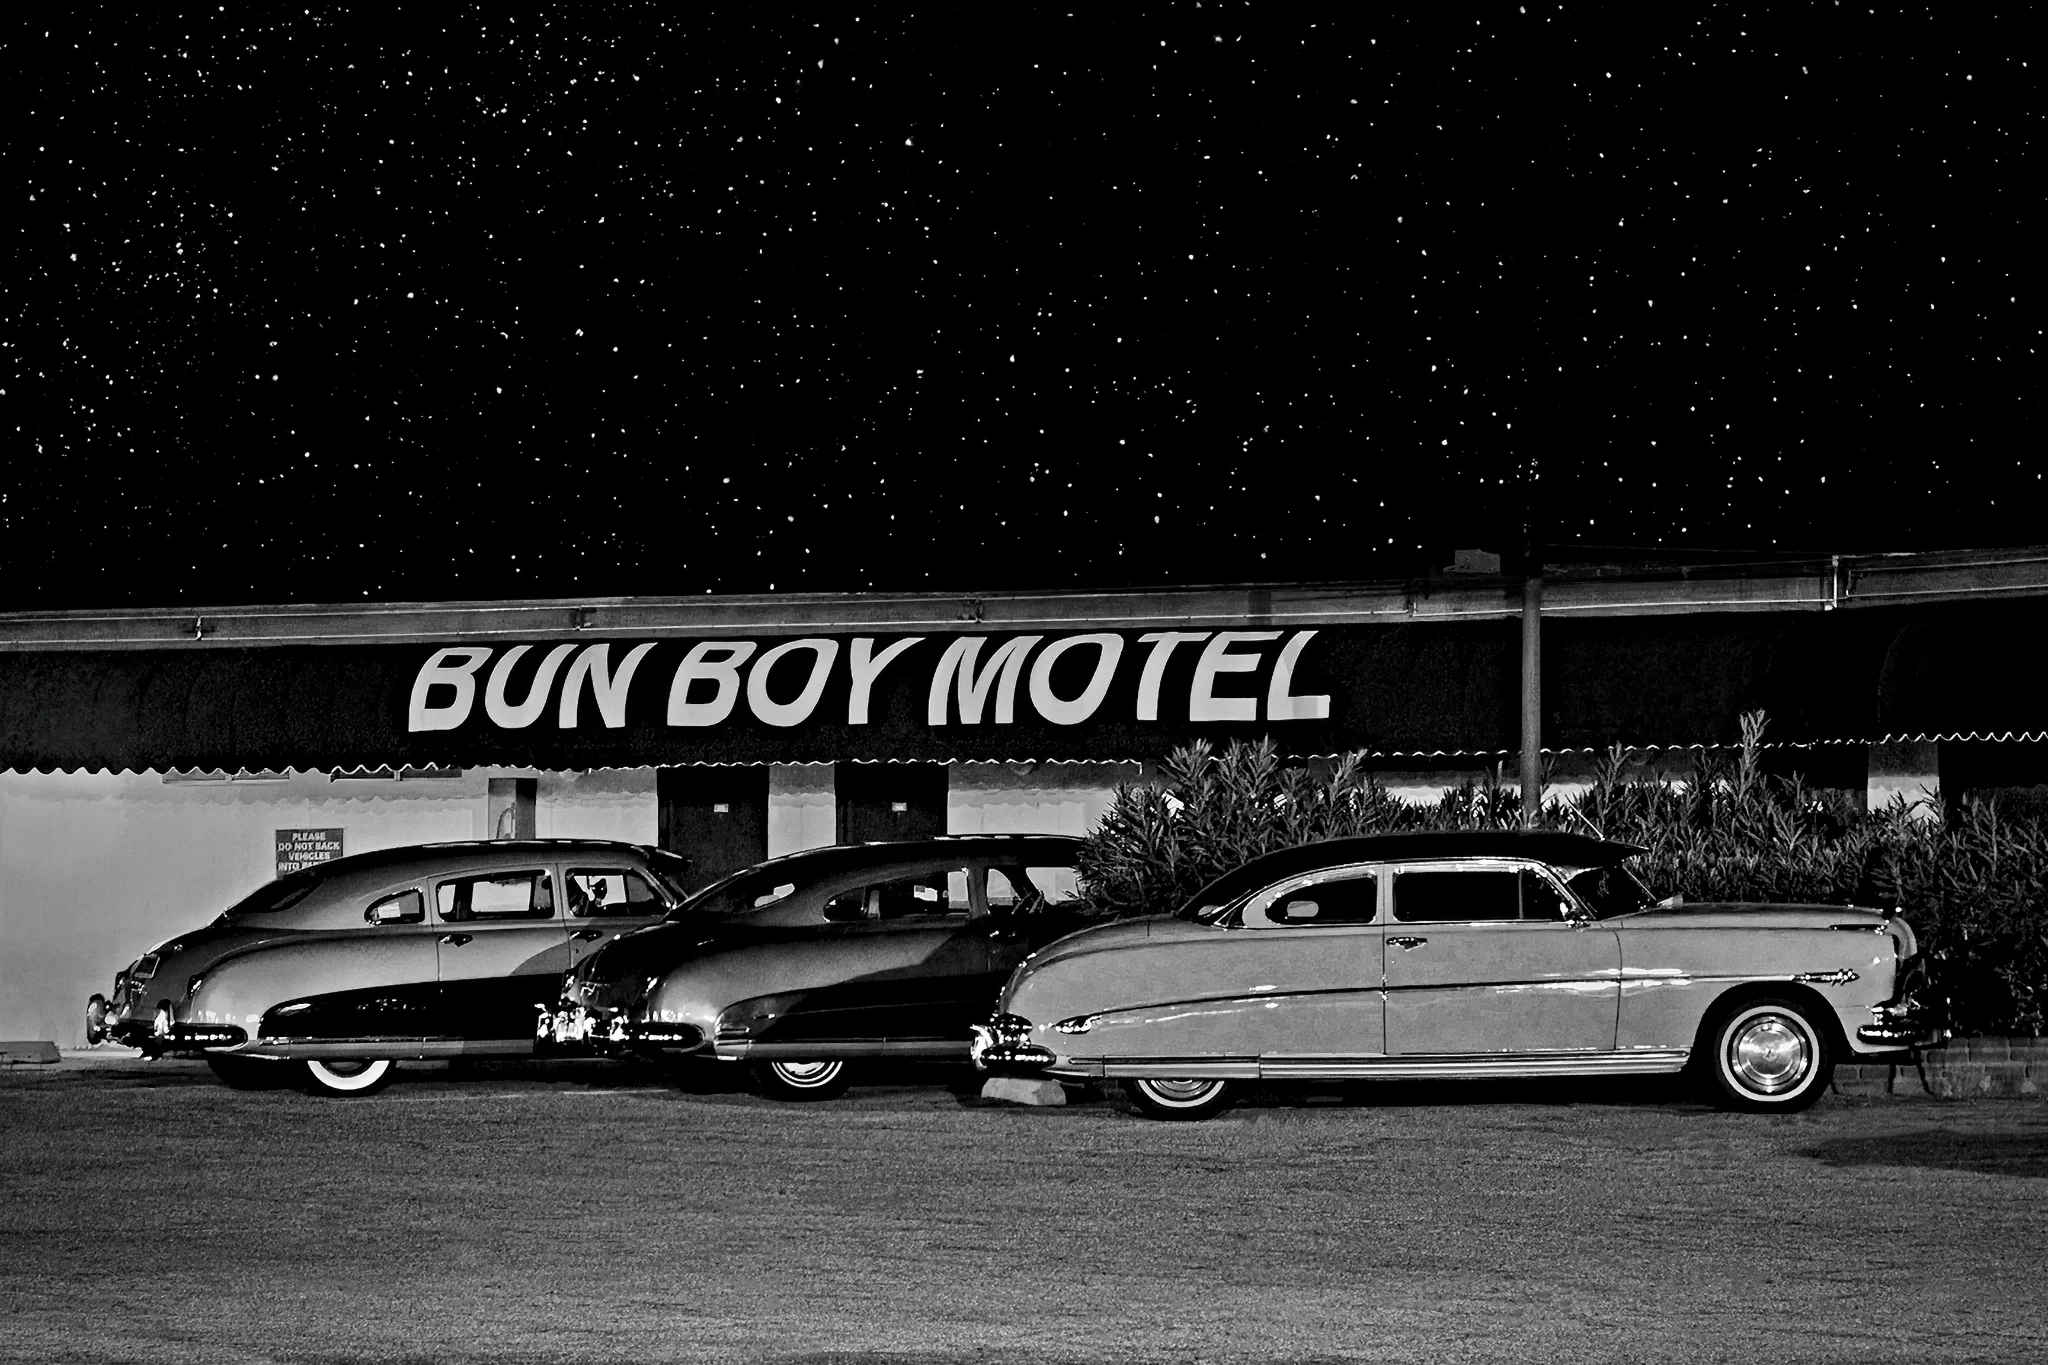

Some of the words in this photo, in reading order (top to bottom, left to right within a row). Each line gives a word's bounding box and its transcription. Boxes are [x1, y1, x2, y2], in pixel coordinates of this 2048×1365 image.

[409, 642, 658, 732] BUN
[667, 636, 924, 729] BOY
[928, 631, 1331, 726] MOTEL
[292, 831, 326, 841] PLEASE
[278, 842, 292, 851] DO
[294, 842, 314, 851] NOT
[315, 841, 340, 851] BACK
[288, 851, 331, 861] VEHICLES
[278, 861, 300, 871] INTO
